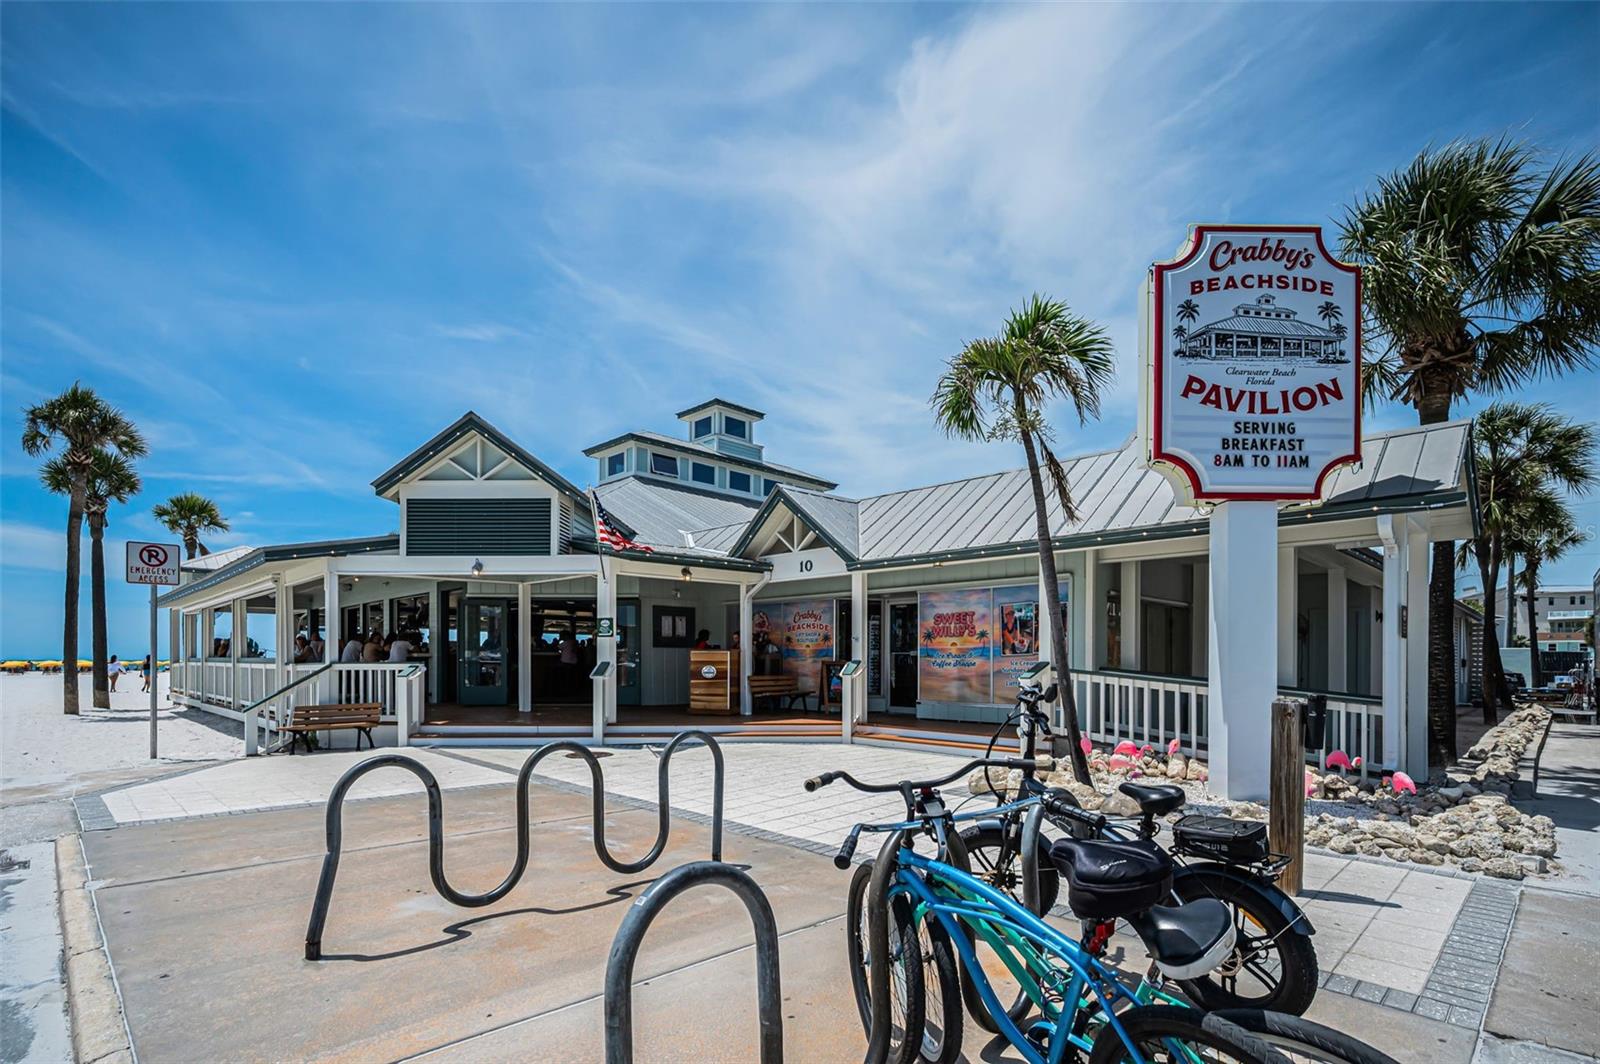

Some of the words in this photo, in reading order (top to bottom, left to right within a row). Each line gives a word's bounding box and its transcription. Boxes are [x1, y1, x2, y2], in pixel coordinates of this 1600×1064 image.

[1209, 238, 1316, 271] Crabby's
[1190, 274, 1334, 296] BEACHSIDE
[1225, 366, 1270, 376] Clearwater
[1272, 368, 1297, 377] Beach
[1245, 376, 1276, 386] Florida
[1180, 374, 1344, 414] PAVILION
[1234, 421, 1296, 435] SERVING
[1221, 438, 1305, 451] BREAKFAST
[1213, 454, 1244, 467] 8AM
[1252, 455, 1270, 467] TO
[1277, 455, 1309, 468] 11AM
[130, 566, 176, 576] EMERGENCY
[800, 559, 813, 572] 10
[139, 575, 168, 583] ACCESS
[933, 611, 976, 625] SWEET
[932, 623, 977, 638] WILLY'S
